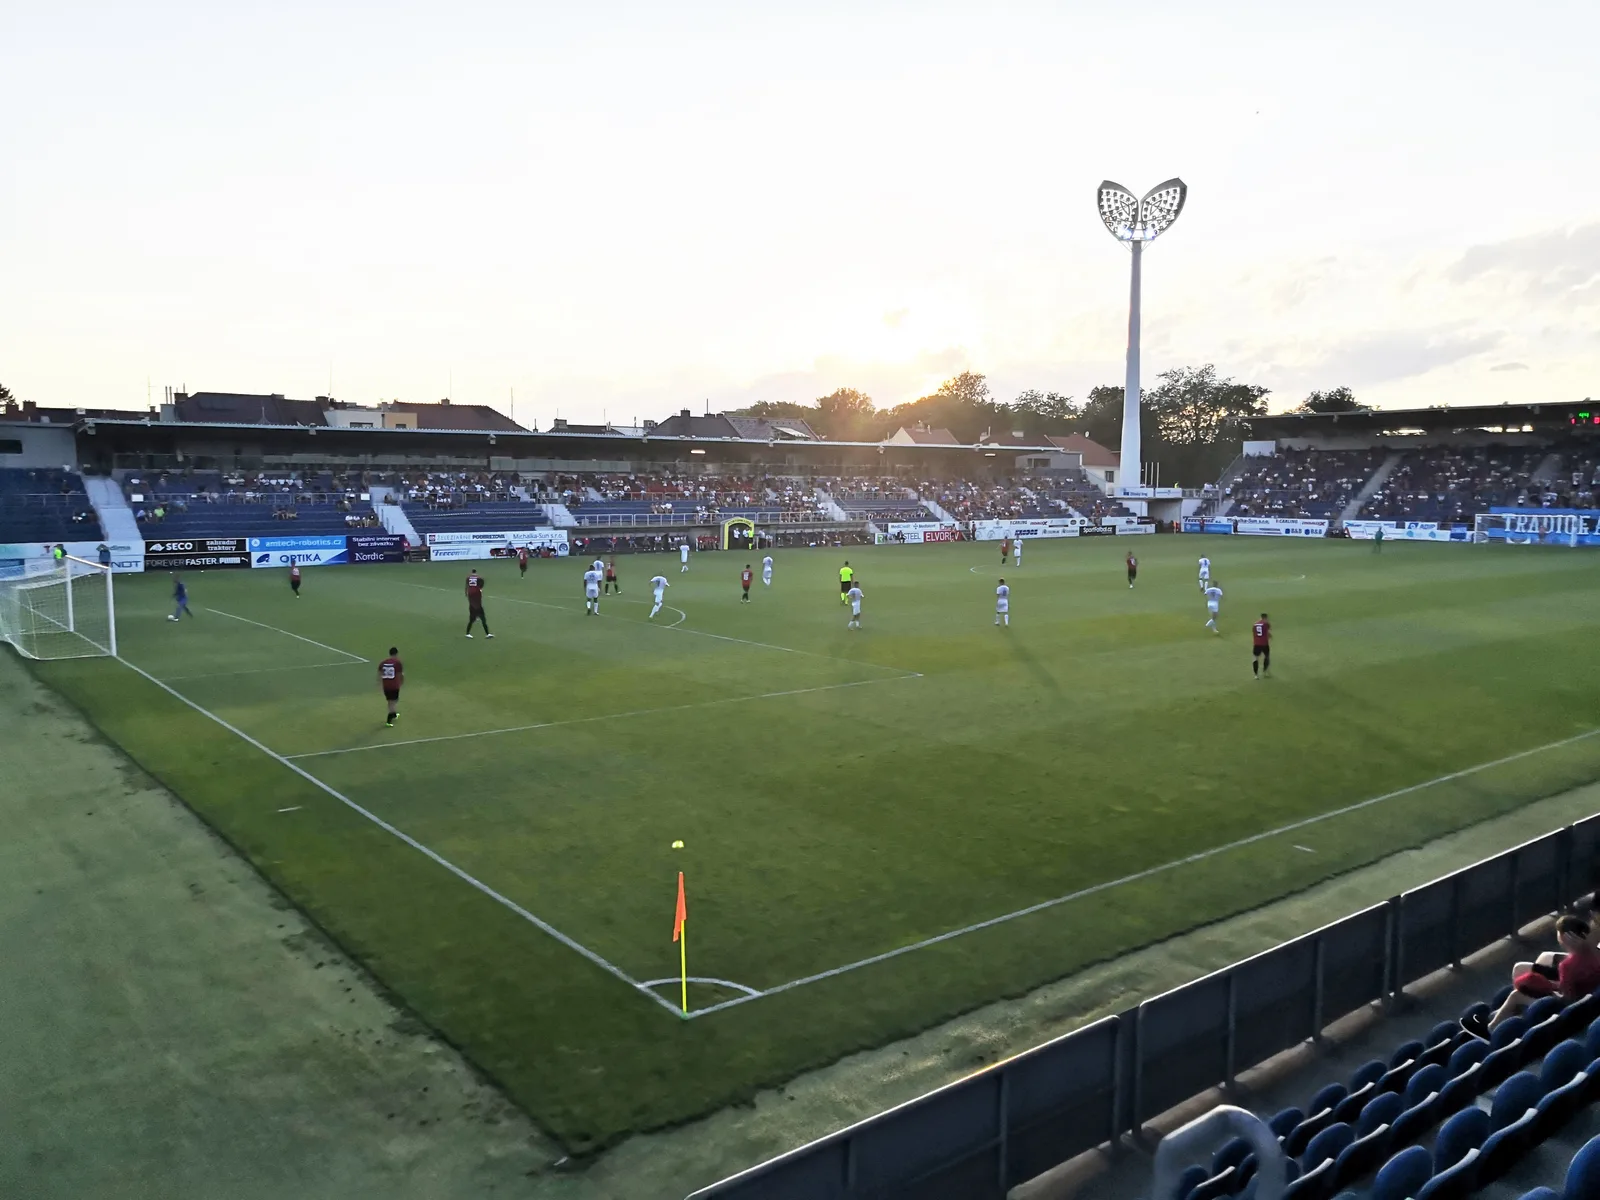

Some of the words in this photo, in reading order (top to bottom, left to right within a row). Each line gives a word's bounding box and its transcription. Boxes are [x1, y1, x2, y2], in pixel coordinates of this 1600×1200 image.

[166, 542, 193, 551] SECO
[265, 539, 342, 547] amtech-robotics.cz
[280, 553, 322, 563] OPTIKA
[355, 552, 385, 561] Nordic
[145, 559, 184, 567] FOREVER
[1256, 625, 1263, 637] 9
